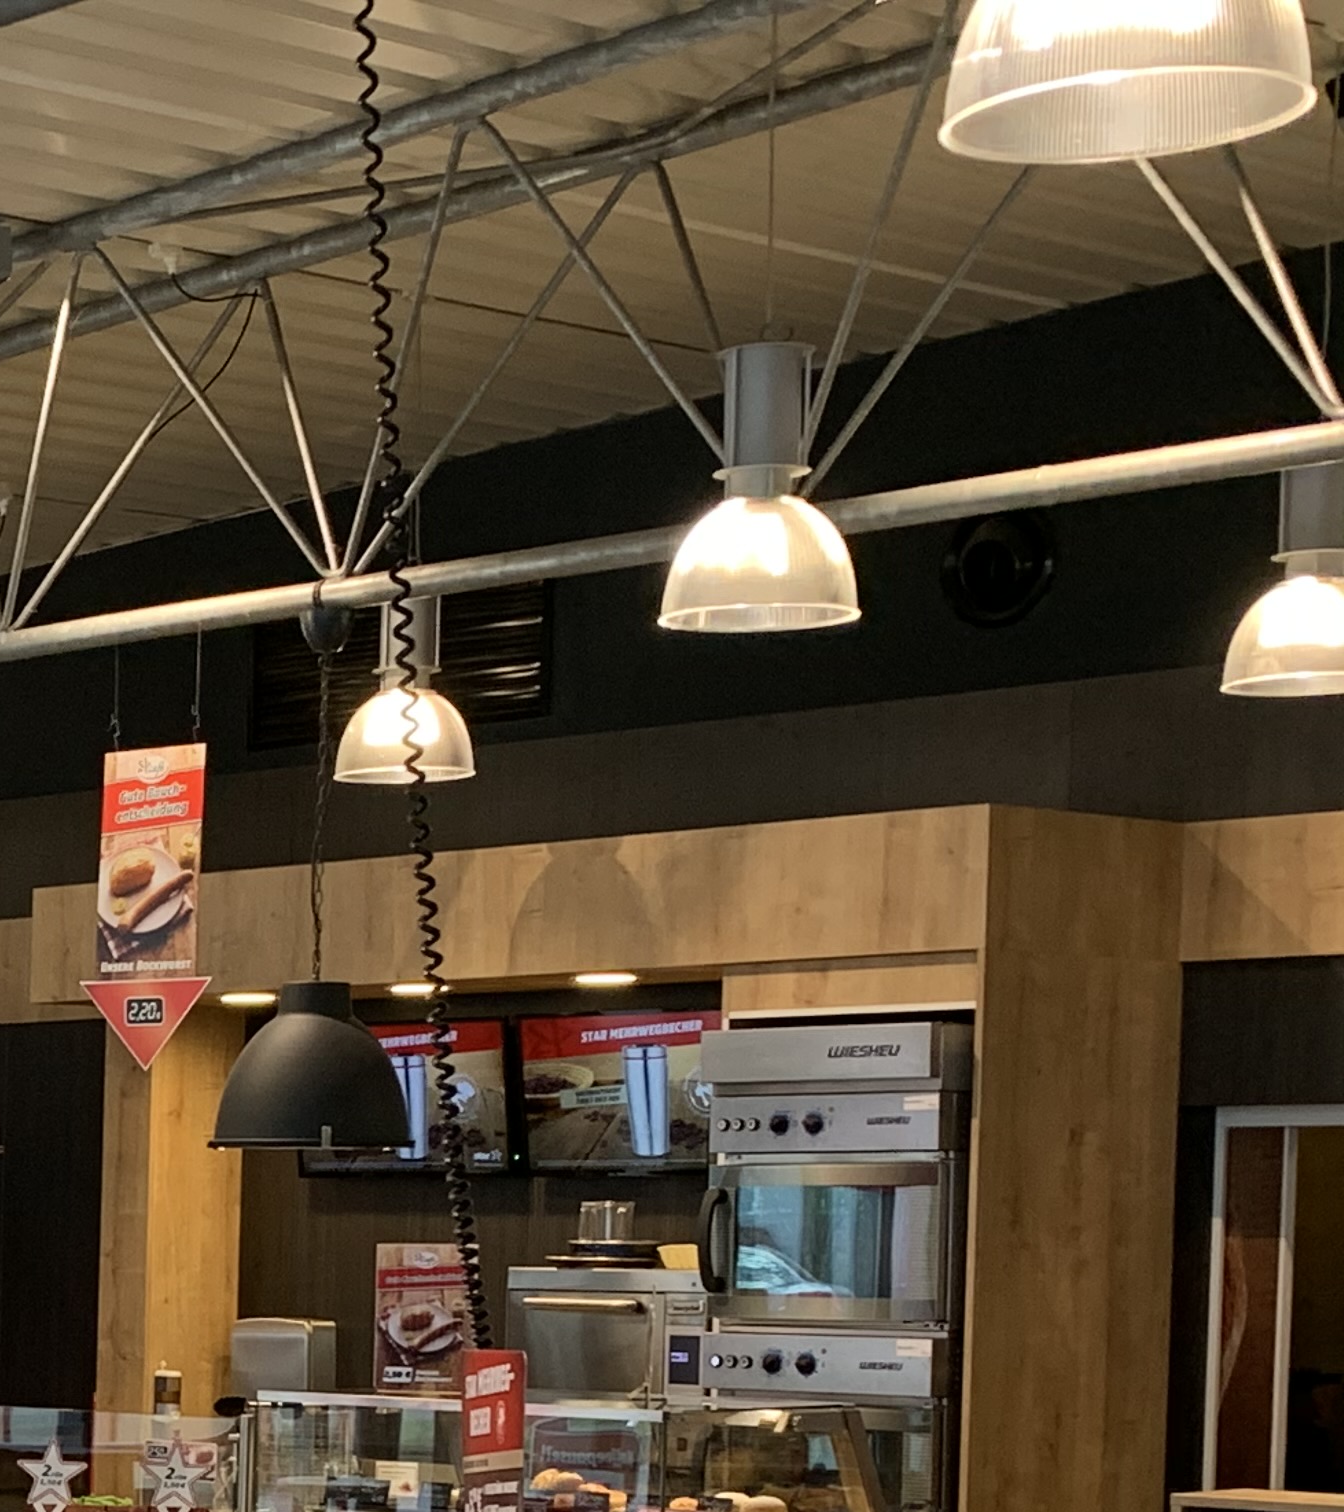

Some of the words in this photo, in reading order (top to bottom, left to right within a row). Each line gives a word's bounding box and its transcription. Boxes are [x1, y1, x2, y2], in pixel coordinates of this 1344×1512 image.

[118, 788, 145, 805] Gute
[115, 801, 189, 823] entscheidung
[581, 1029, 608, 1044] STAR
[827, 1044, 901, 1058] WIESHEU
[42, 1464, 52, 1477] 2
[165, 1467, 175, 1480] 2
